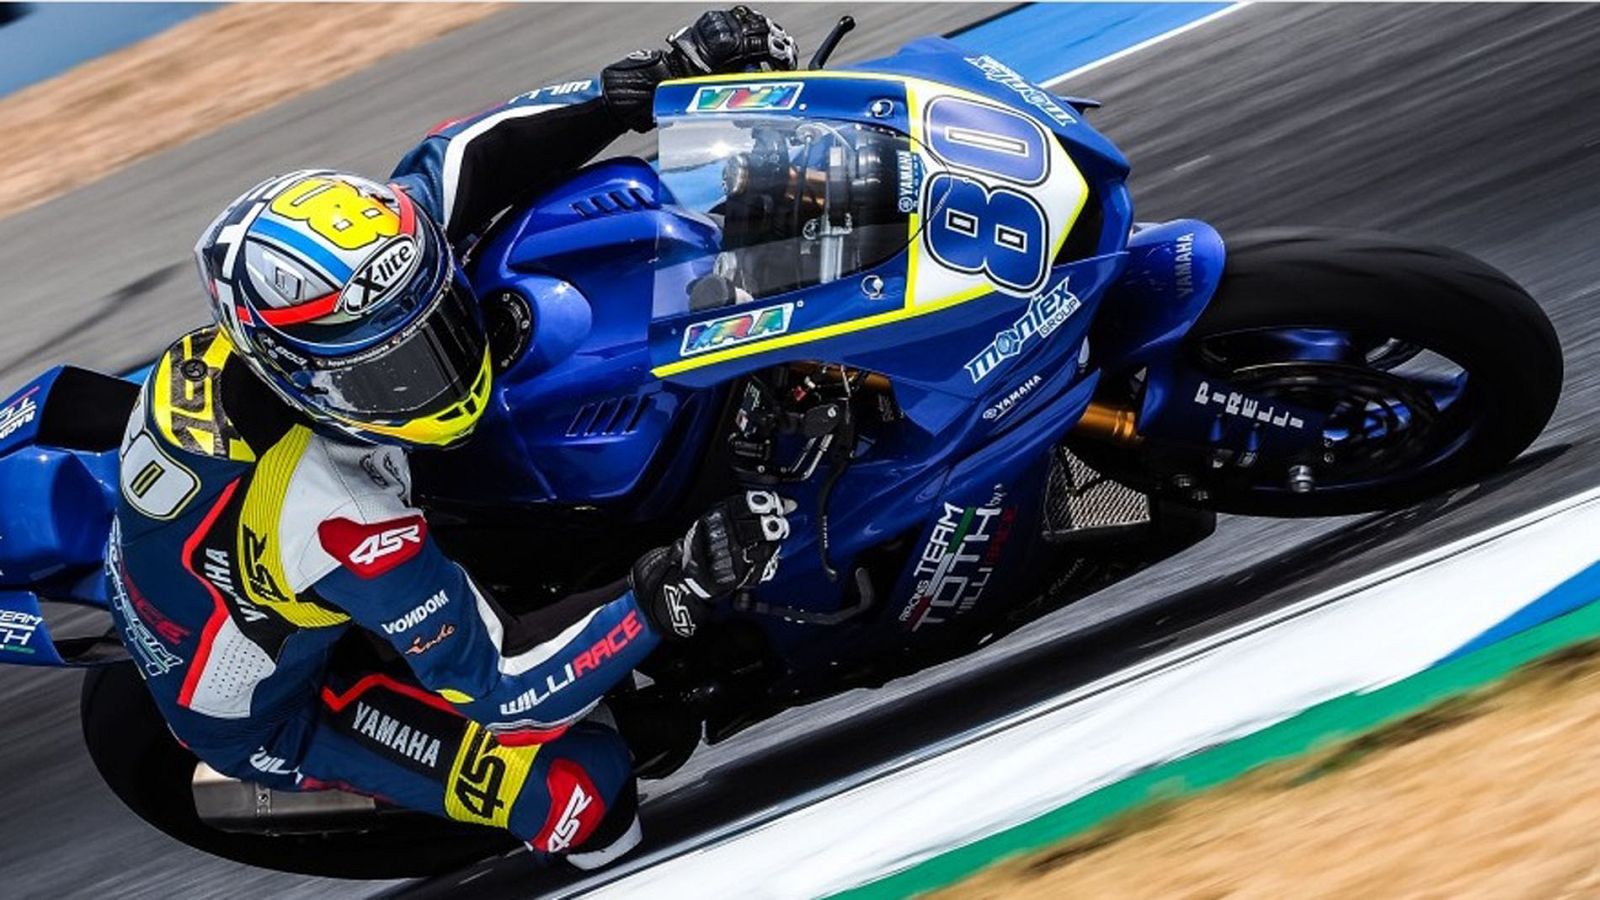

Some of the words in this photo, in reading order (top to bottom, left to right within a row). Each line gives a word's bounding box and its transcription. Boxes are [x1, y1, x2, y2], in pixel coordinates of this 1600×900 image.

[922, 94, 1051, 295] 80
[351, 243, 413, 309] X-lite
[1175, 232, 1194, 298] YAMAHA
[681, 303, 793, 356] MRA
[1038, 298, 1081, 338] GROUP
[996, 374, 1043, 412] YAMAHA
[1194, 381, 1304, 429] PIRELLI
[349, 527, 421, 566] 4SR
[913, 501, 965, 577] TEAM
[911, 507, 1002, 632] TOTH
[381, 590, 449, 635] VONDOM
[351, 701, 442, 768] YAMAHA
